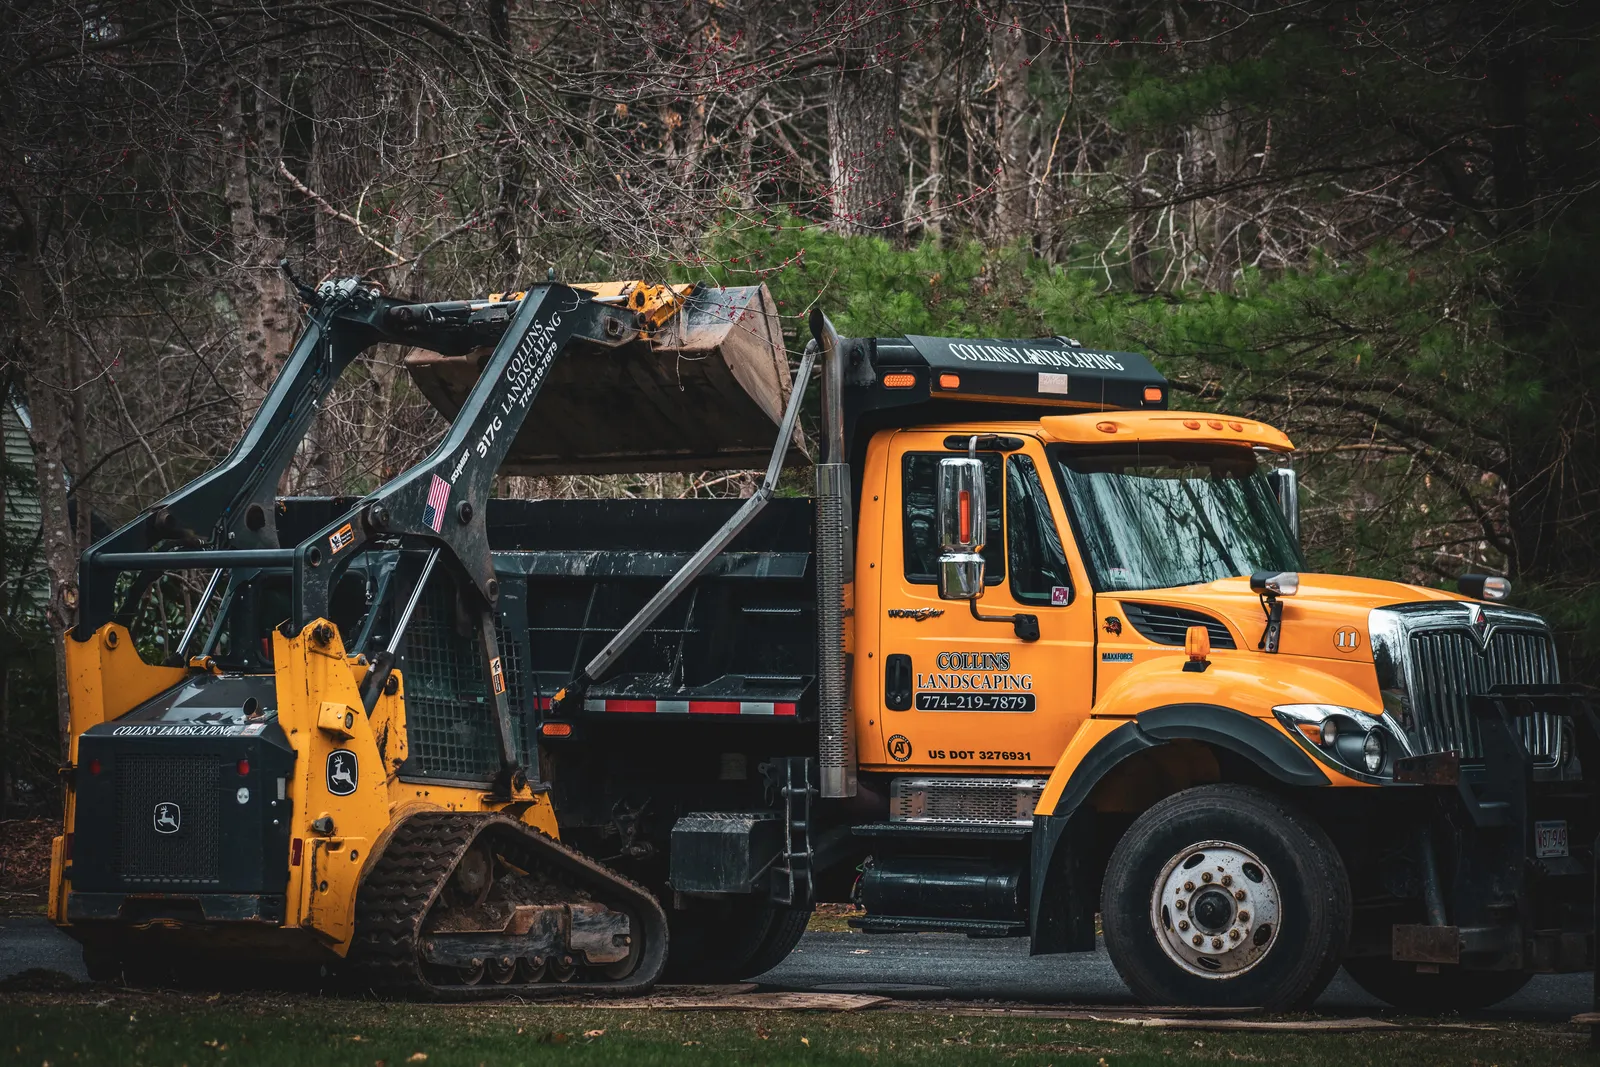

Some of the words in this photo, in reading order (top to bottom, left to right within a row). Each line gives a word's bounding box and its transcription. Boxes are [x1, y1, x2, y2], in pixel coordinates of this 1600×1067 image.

[506, 319, 544, 382] COLLINS
[948, 343, 1018, 363] COLLINS
[1014, 348, 1124, 371] LANDSCAPING
[501, 311, 561, 416] LANDSCAPING
[518, 341, 558, 408] 774-219-7879
[476, 416, 502, 458] 317G
[1336, 631, 1357, 648] 11
[936, 652, 1010, 671] COLLINS
[916, 673, 1033, 690] LANDSCAPING
[922, 696, 1027, 709] 774-219-7879
[112, 725, 157, 736] COLLINS
[928, 750, 946, 759] US
[949, 750, 975, 760] DOT
[979, 751, 1031, 761] 3276931
